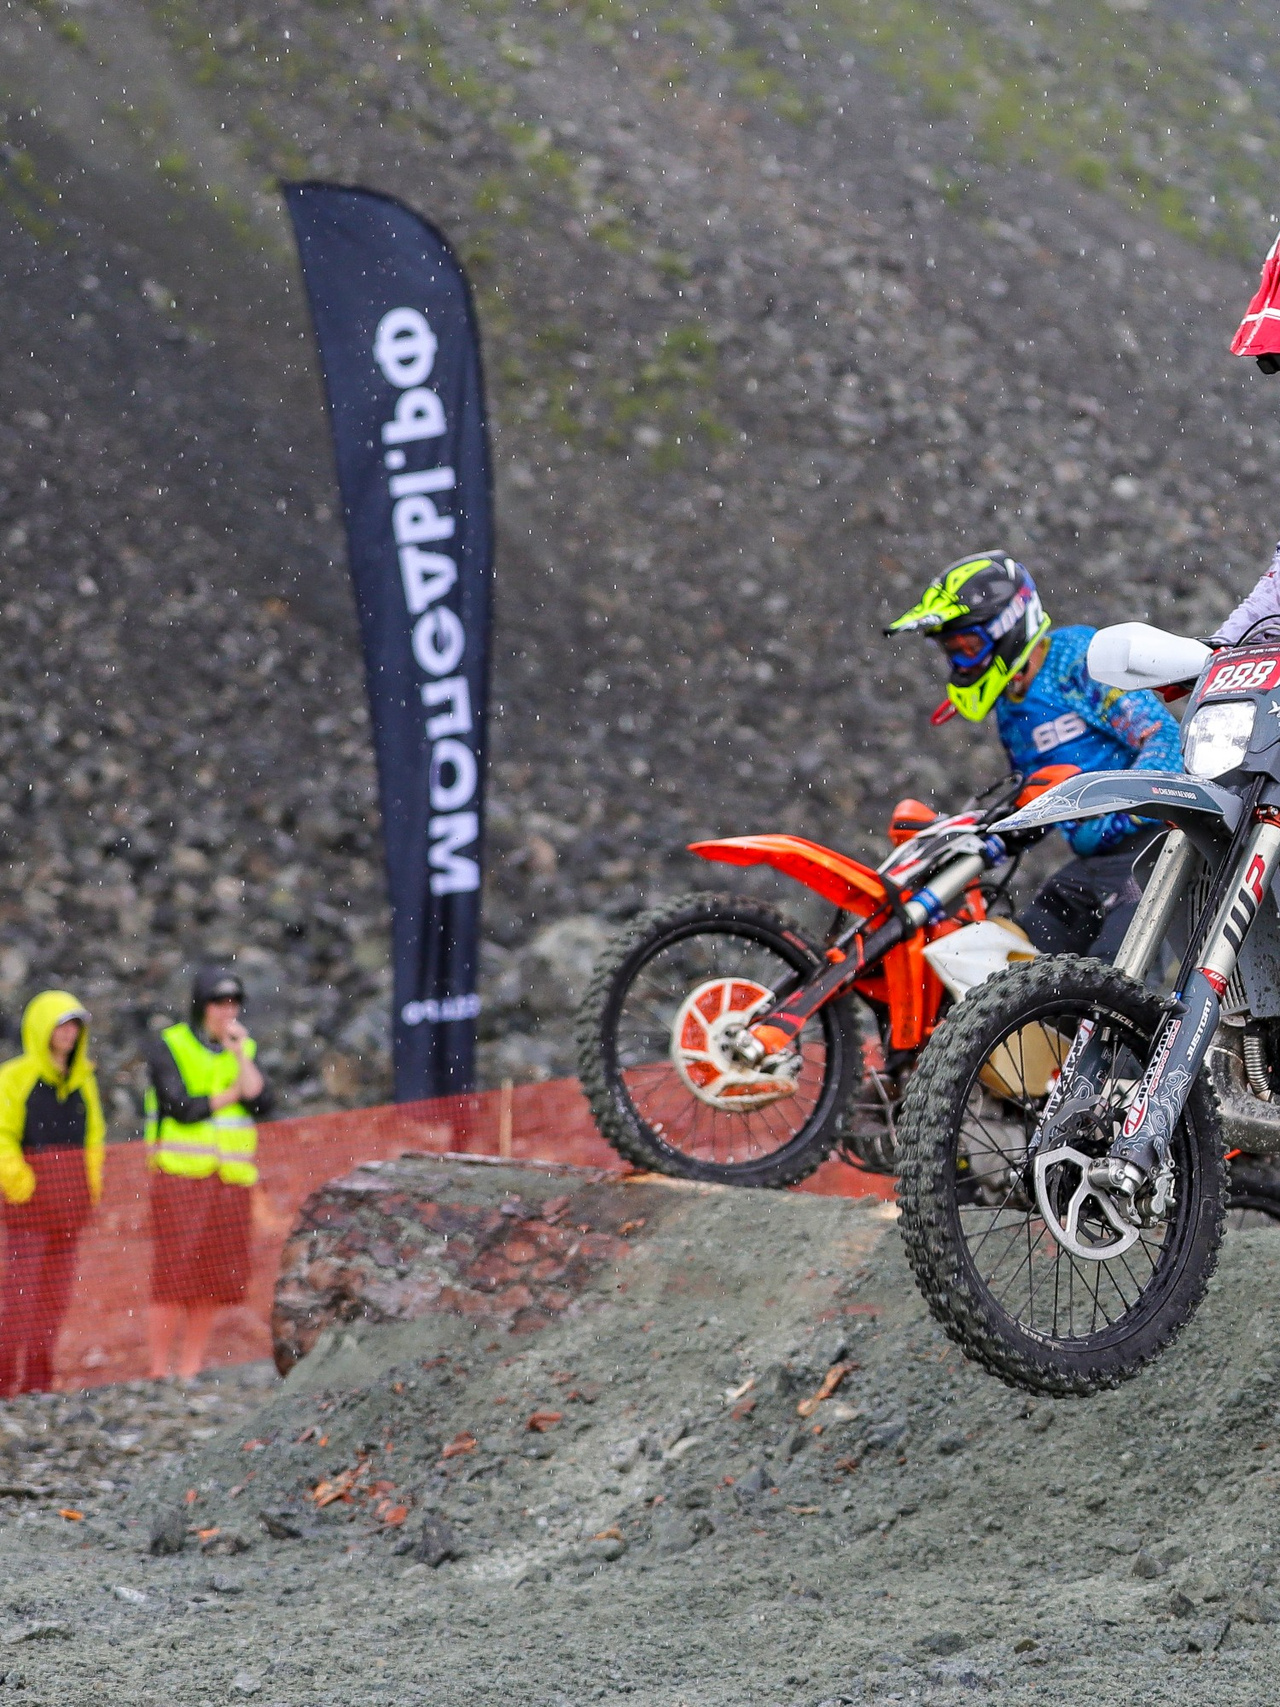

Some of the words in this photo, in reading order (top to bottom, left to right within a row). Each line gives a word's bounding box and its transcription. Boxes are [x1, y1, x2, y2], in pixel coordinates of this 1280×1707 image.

[1204, 660, 1278, 695] 888
[1110, 1011, 1134, 1030] EXCEL
[1186, 997, 1214, 1062] JUSTCAT
